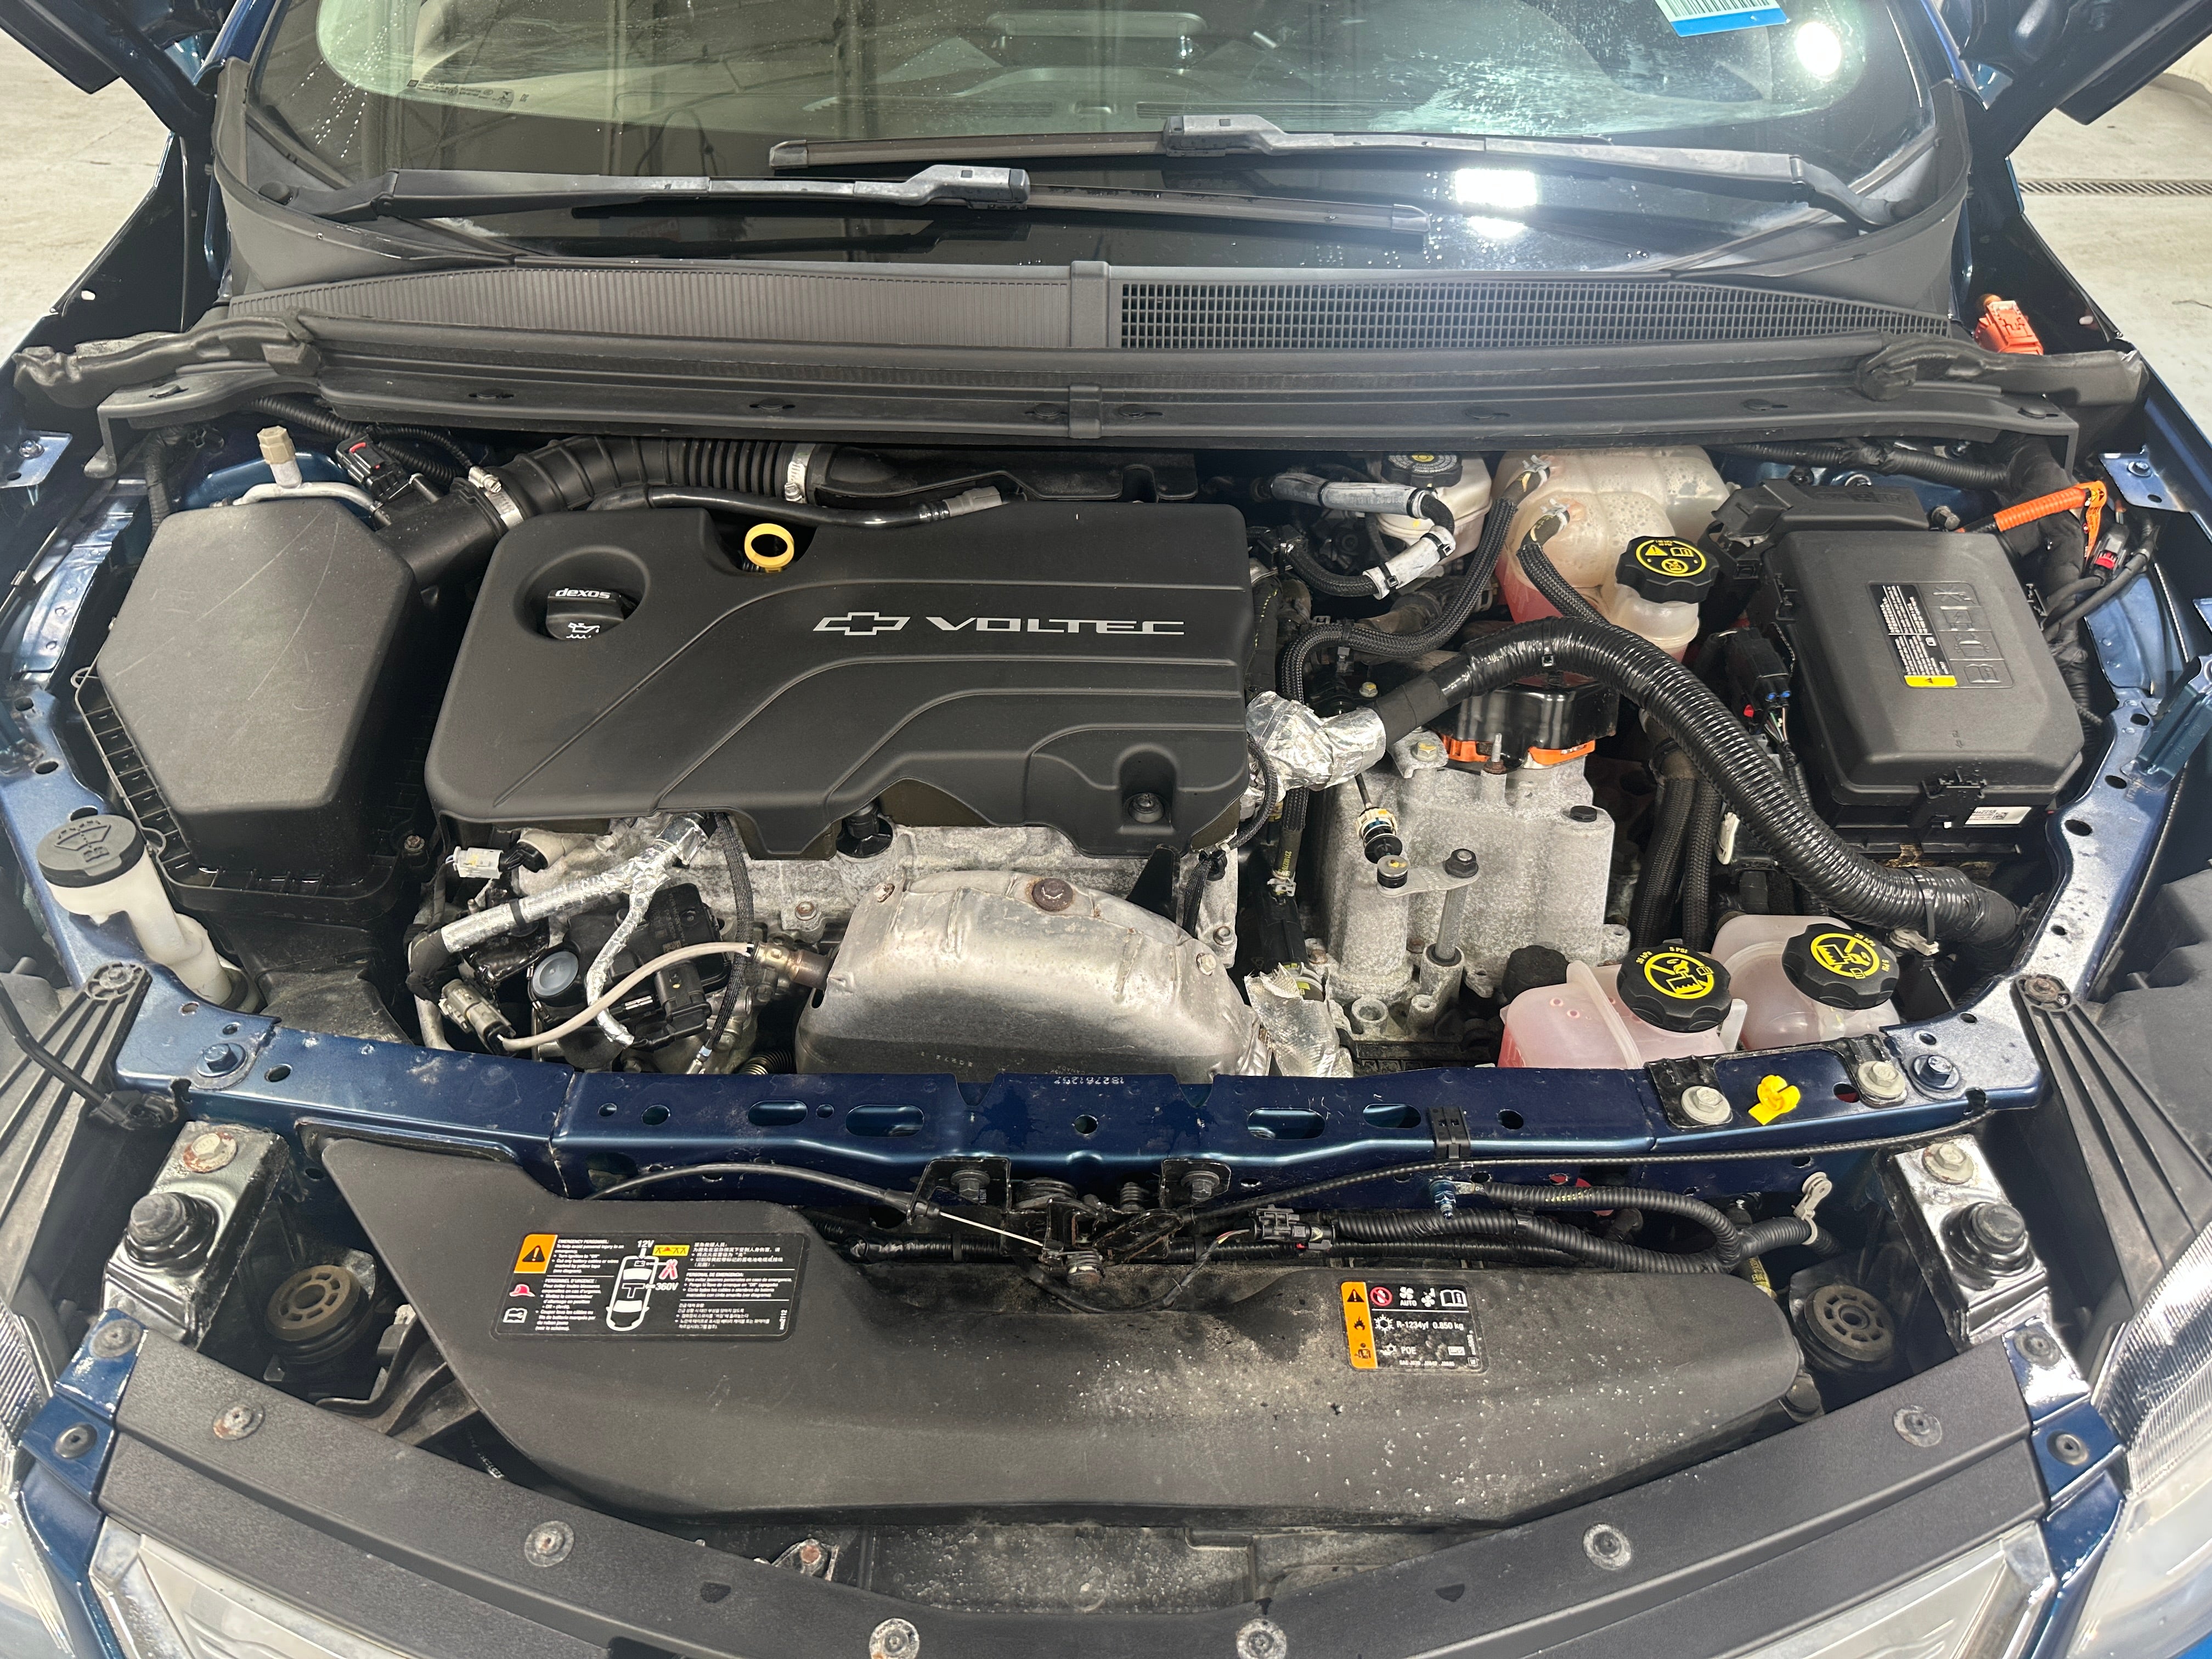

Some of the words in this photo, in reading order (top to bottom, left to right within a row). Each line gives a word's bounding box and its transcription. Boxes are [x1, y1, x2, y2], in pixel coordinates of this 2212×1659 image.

[555, 588, 612, 599] dexos
[926, 616, 1185, 635] VOLTEC
[1863, 938, 1876, 947] kPa
[1641, 951, 1653, 959] kPa
[1881, 963, 1890, 972] PSI
[637, 1240, 654, 1248] 12V
[655, 1282, 679, 1291] 360V
[1396, 1321, 1429, 1330] R-1234yf
[1454, 1322, 1464, 1330] kg
[1401, 1346, 1417, 1355] POE
